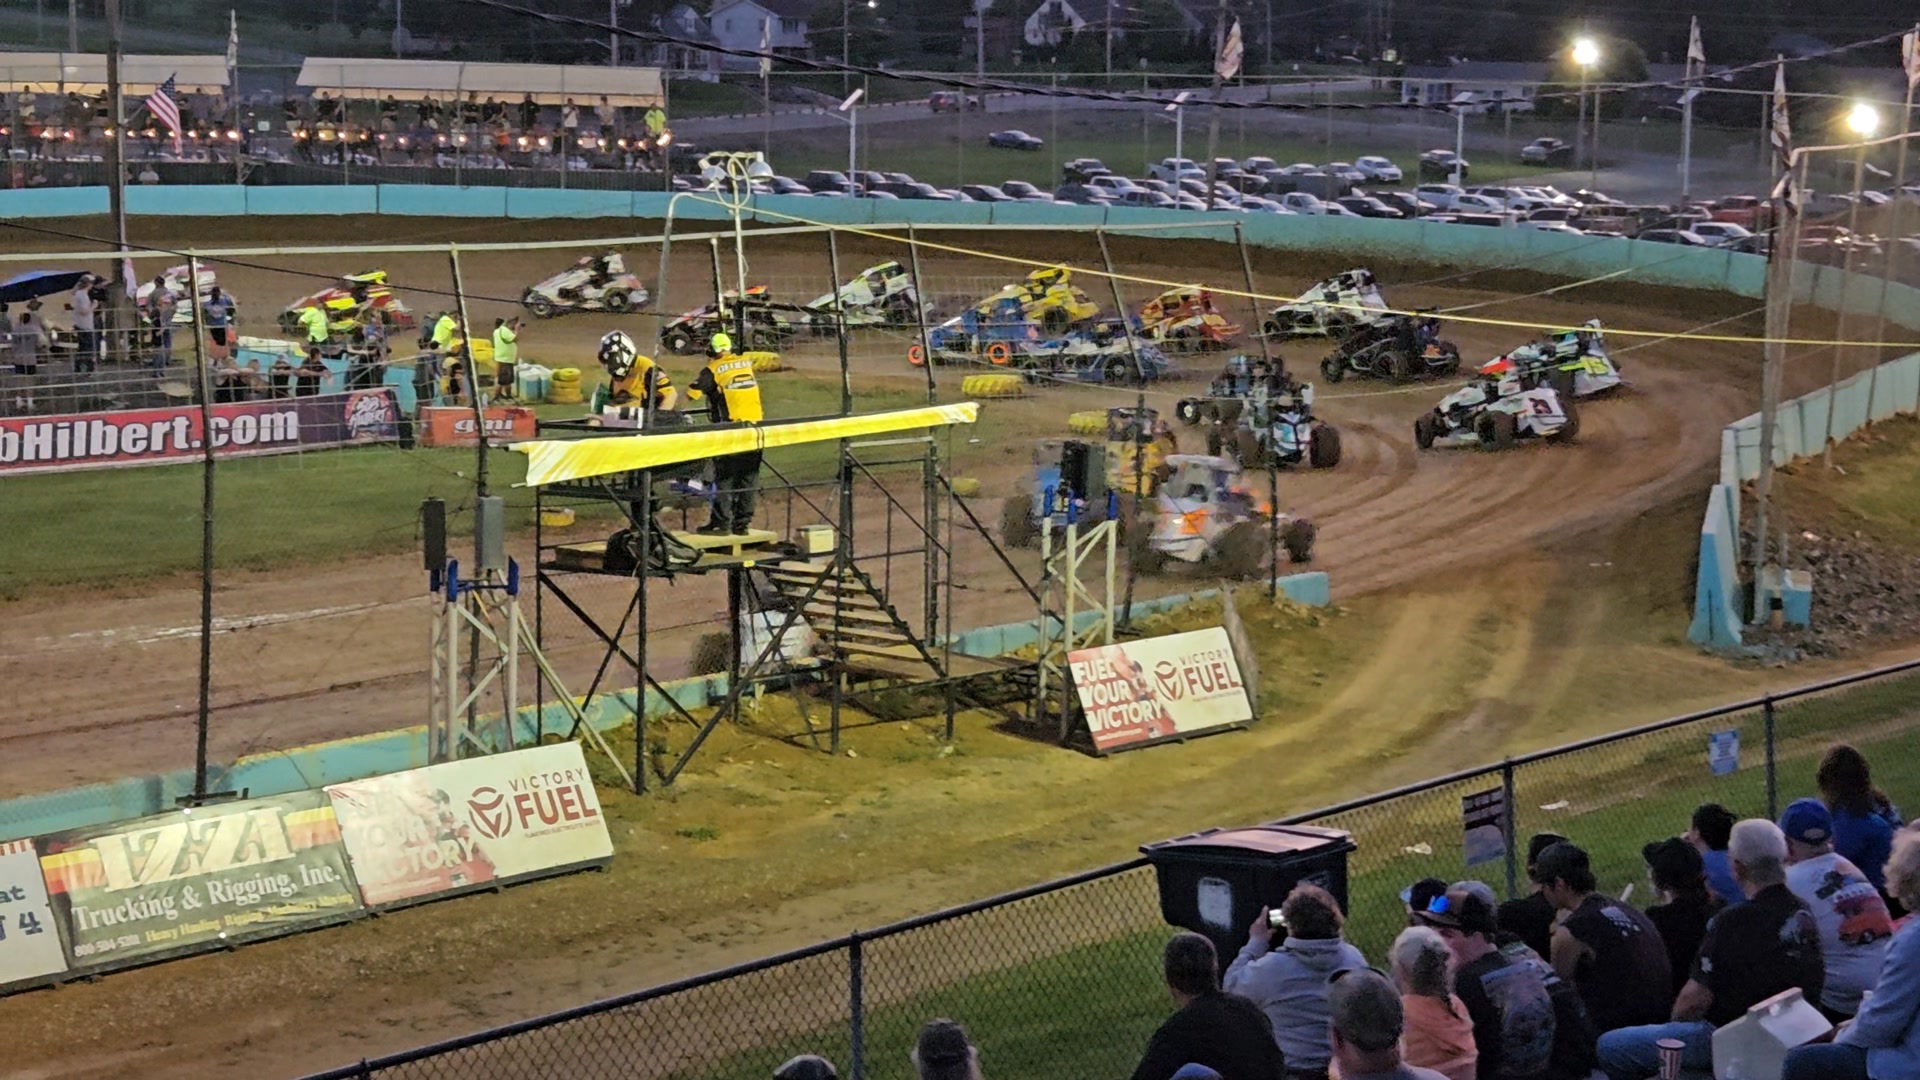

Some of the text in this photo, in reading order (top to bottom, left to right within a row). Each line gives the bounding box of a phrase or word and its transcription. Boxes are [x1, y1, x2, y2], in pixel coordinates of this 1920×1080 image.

[1070, 659, 1117, 685] FUEL
[1179, 649, 1231, 666] VICTORY
[1077, 680, 1134, 708] YOUR
[1183, 663, 1239, 696] FUEL
[1085, 699, 1163, 732] VICTORY
[508, 767, 585, 792] VICTORY
[513, 784, 598, 829] FUEL
[88, 806, 296, 892] IZZI
[71, 894, 178, 931] Trucking
[182, 885, 203, 911] &
[206, 872, 298, 906] Rigging,
[299, 864, 341, 887] Inc.
